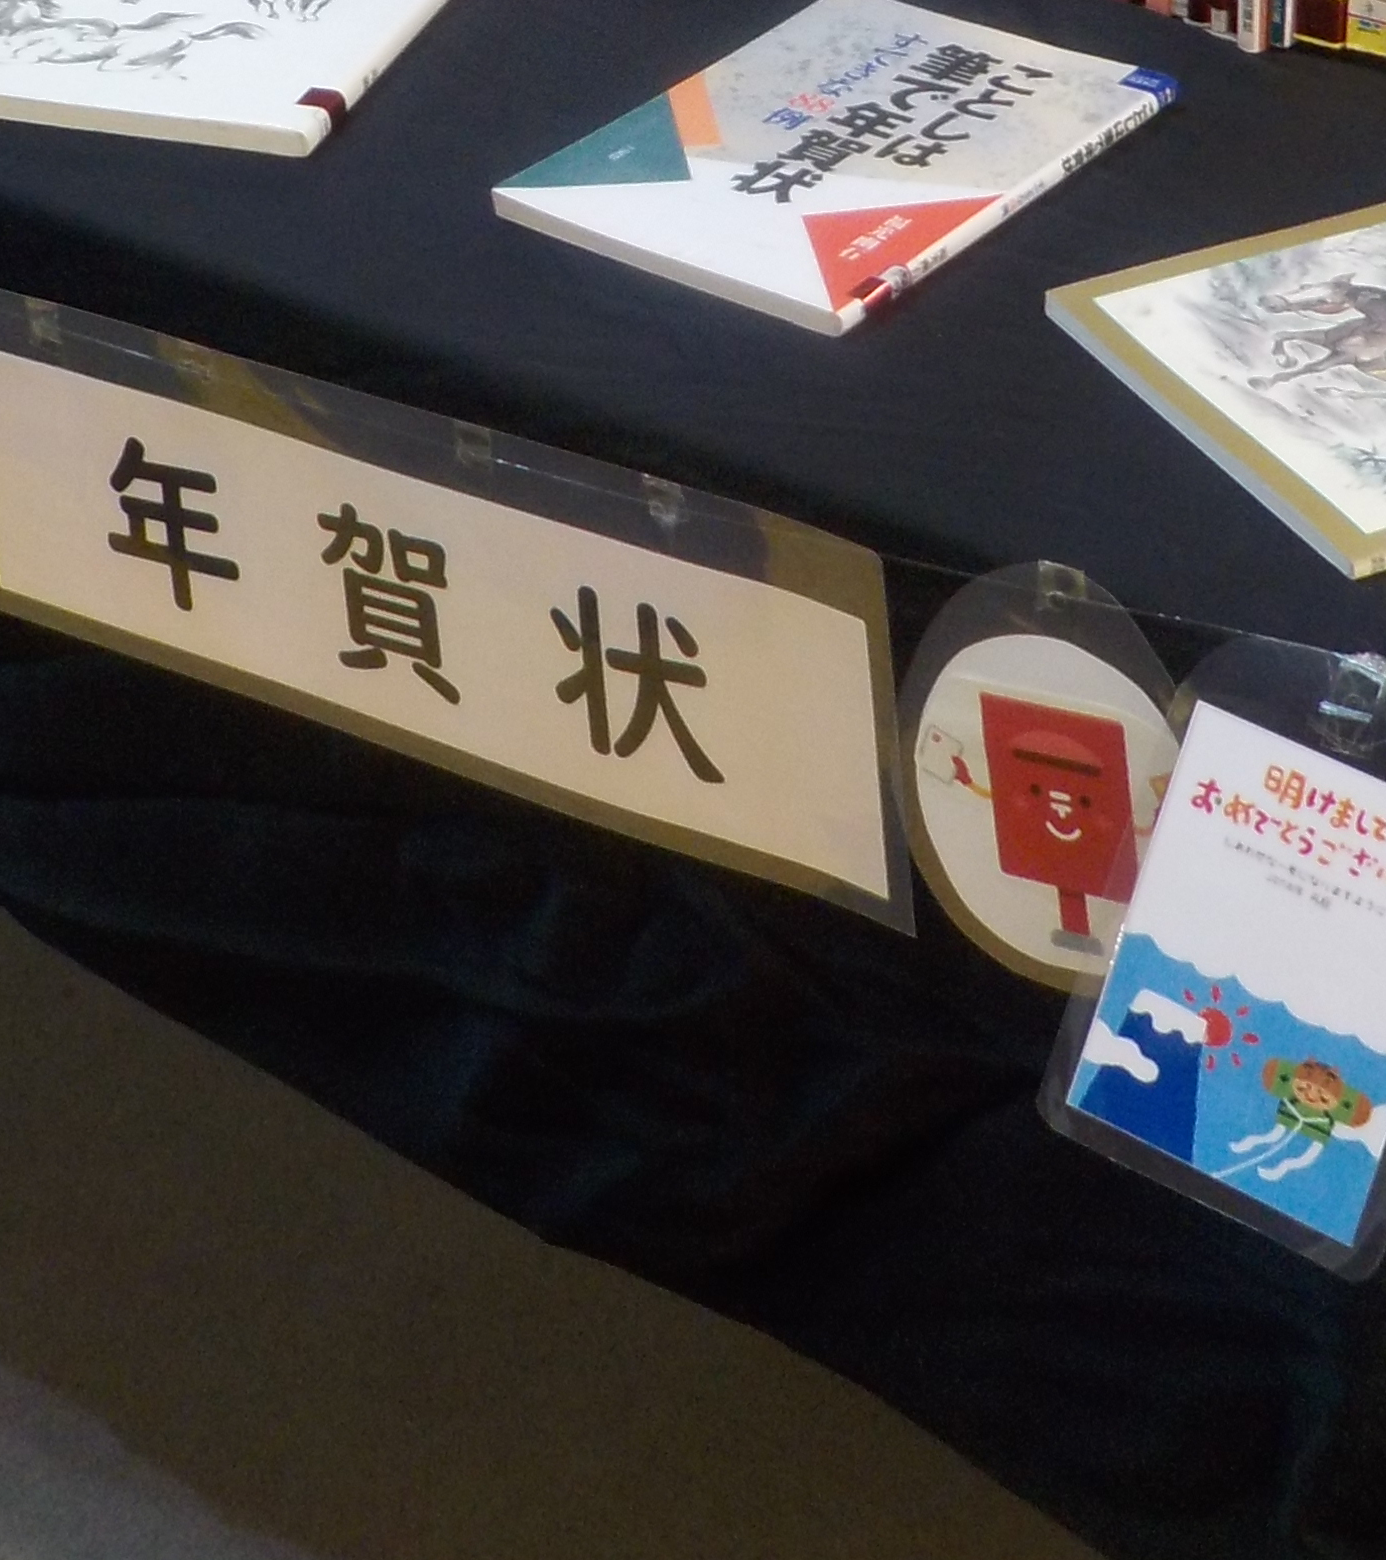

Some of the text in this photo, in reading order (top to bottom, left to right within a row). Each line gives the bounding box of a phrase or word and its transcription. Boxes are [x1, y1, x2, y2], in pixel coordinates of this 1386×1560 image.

[730, 41, 1003, 205] 筆で年賀状
[890, 64, 1053, 168] ことしは
[107, 437, 725, 785] 年賀状
